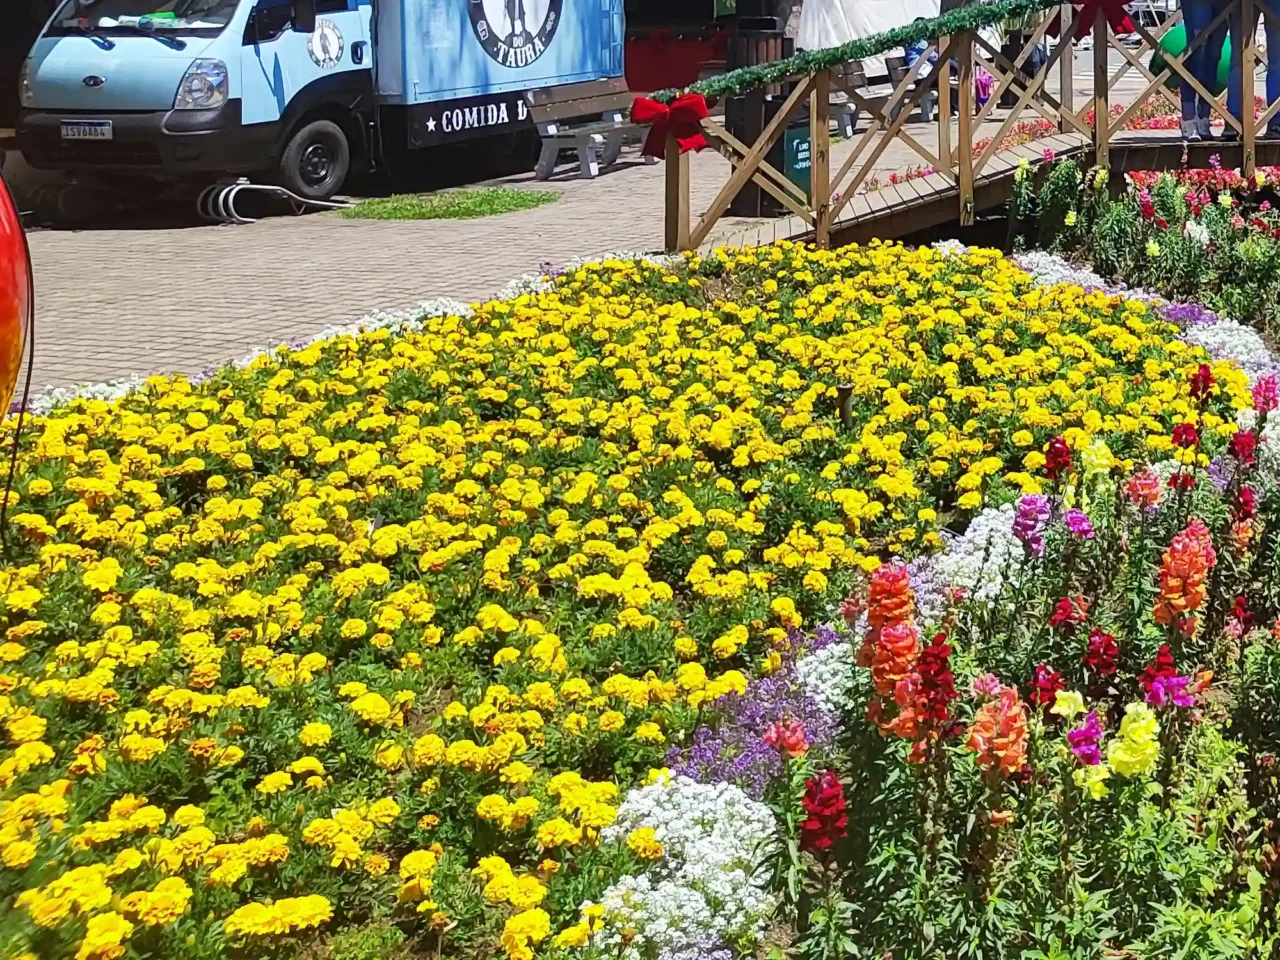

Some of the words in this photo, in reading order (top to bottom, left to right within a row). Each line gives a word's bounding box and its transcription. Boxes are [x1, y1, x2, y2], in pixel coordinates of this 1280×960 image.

[496, 36, 546, 68] TAURA
[512, 36, 524, 48] DO
[441, 102, 510, 133] COMIDA
